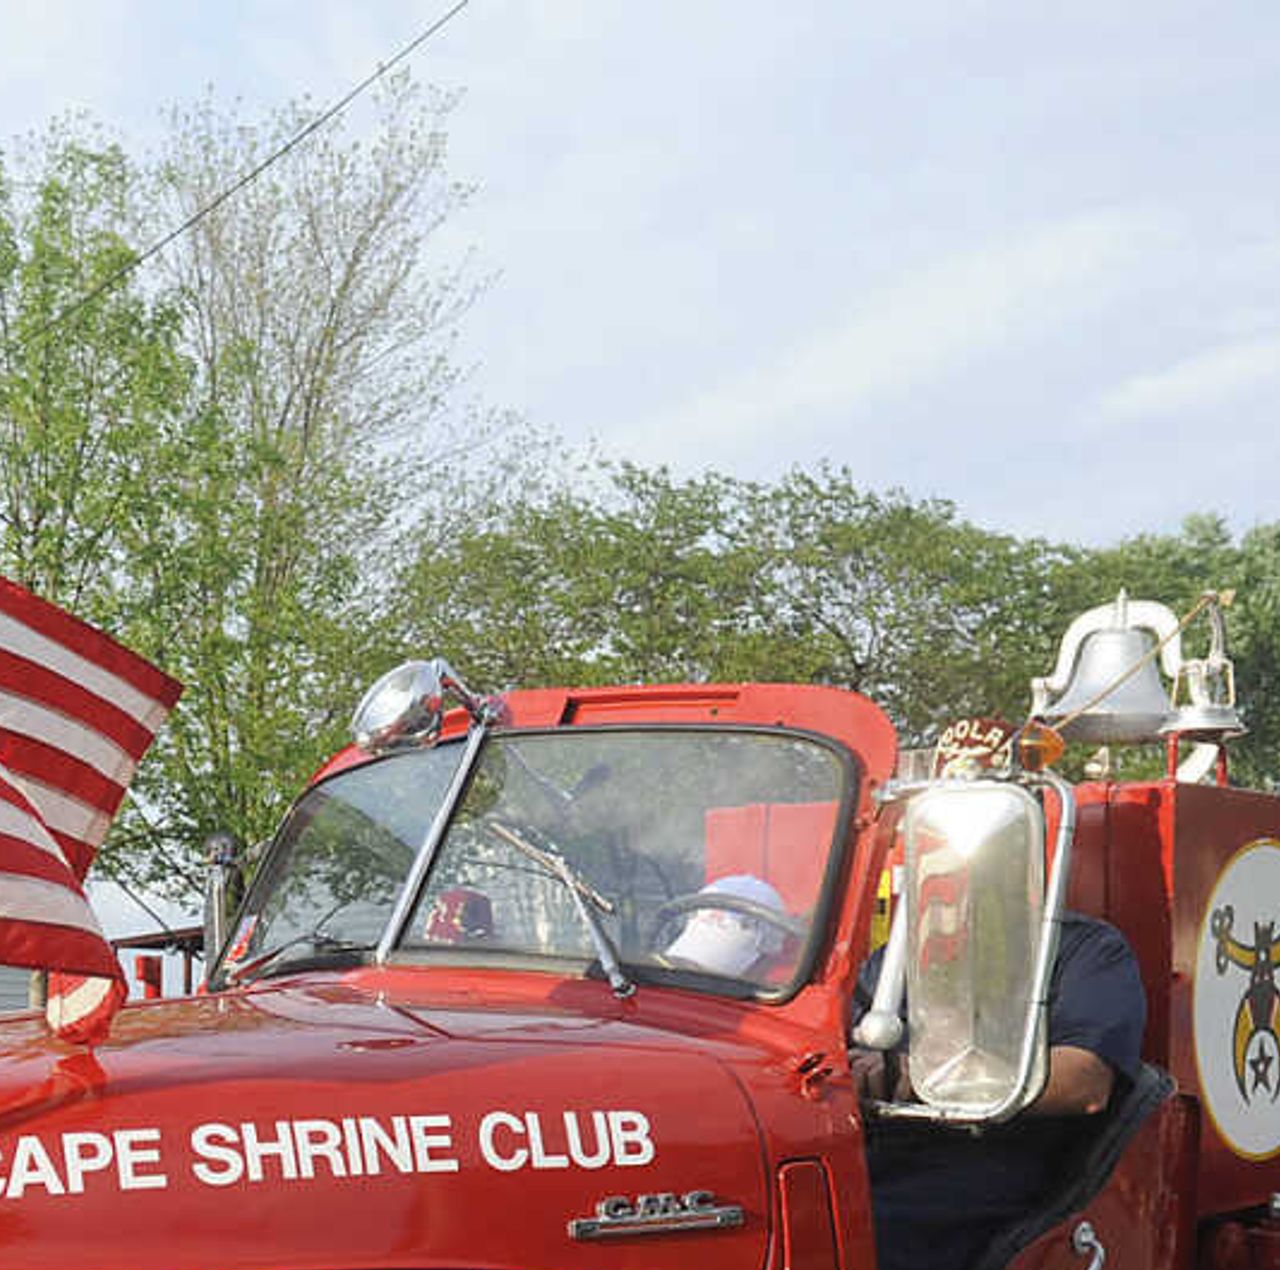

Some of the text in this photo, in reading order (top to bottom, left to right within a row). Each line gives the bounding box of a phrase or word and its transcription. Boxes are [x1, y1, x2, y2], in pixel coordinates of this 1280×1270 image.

[190, 1114, 460, 1186] SHRINE
[478, 1110, 656, 1172] CLUB
[596, 1190, 715, 1222] GMC
